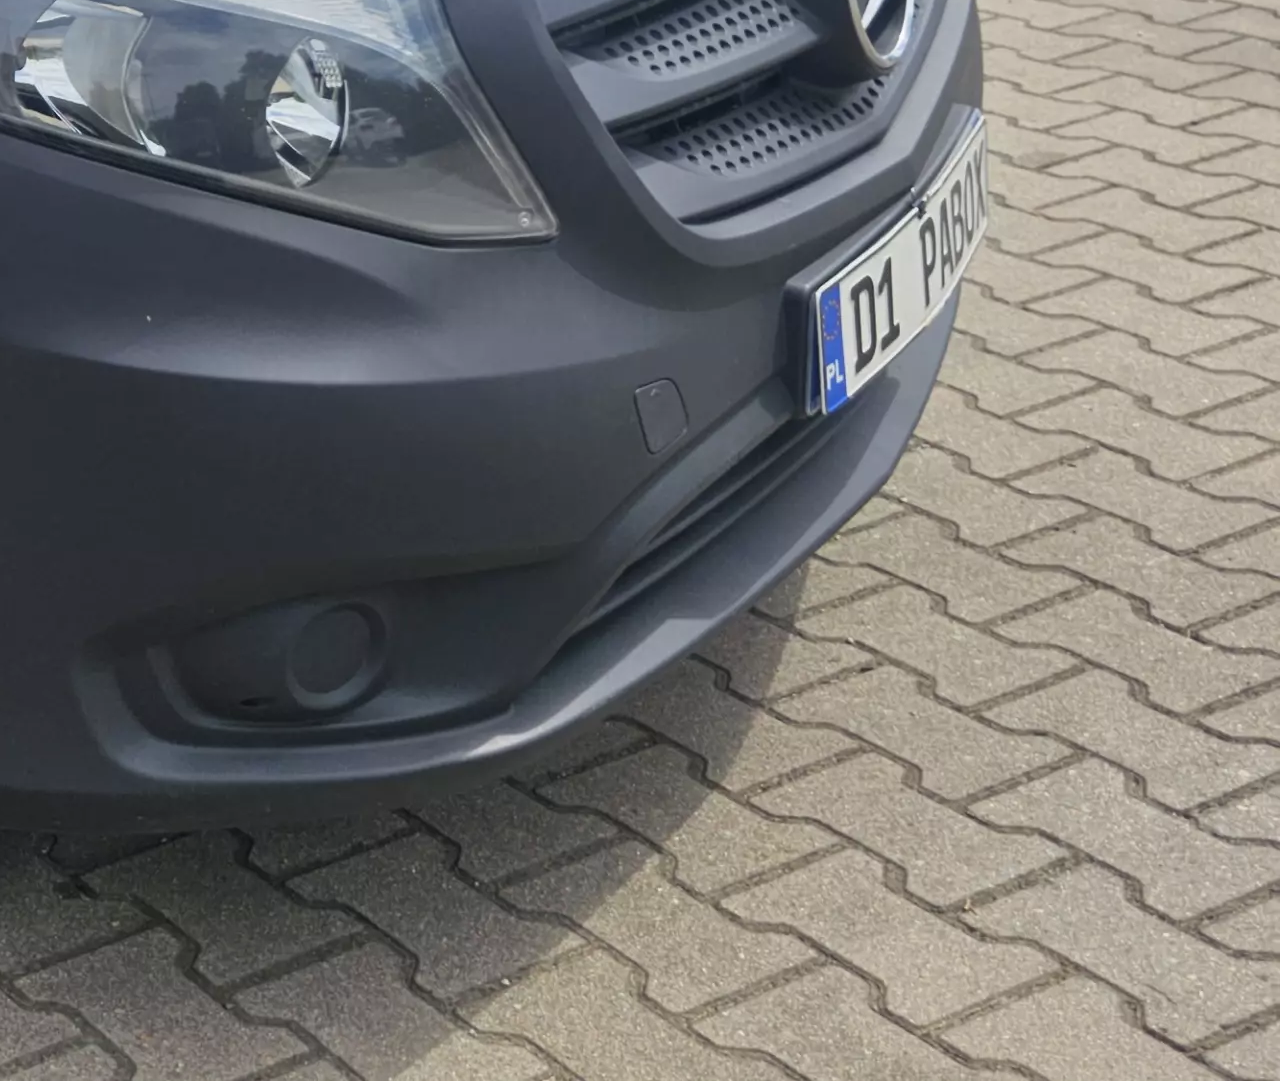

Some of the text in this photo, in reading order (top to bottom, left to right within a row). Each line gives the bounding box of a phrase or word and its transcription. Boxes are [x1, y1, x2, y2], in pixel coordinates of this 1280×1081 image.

[850, 138, 986, 375] D1 PABOX
[826, 360, 844, 390] PL
